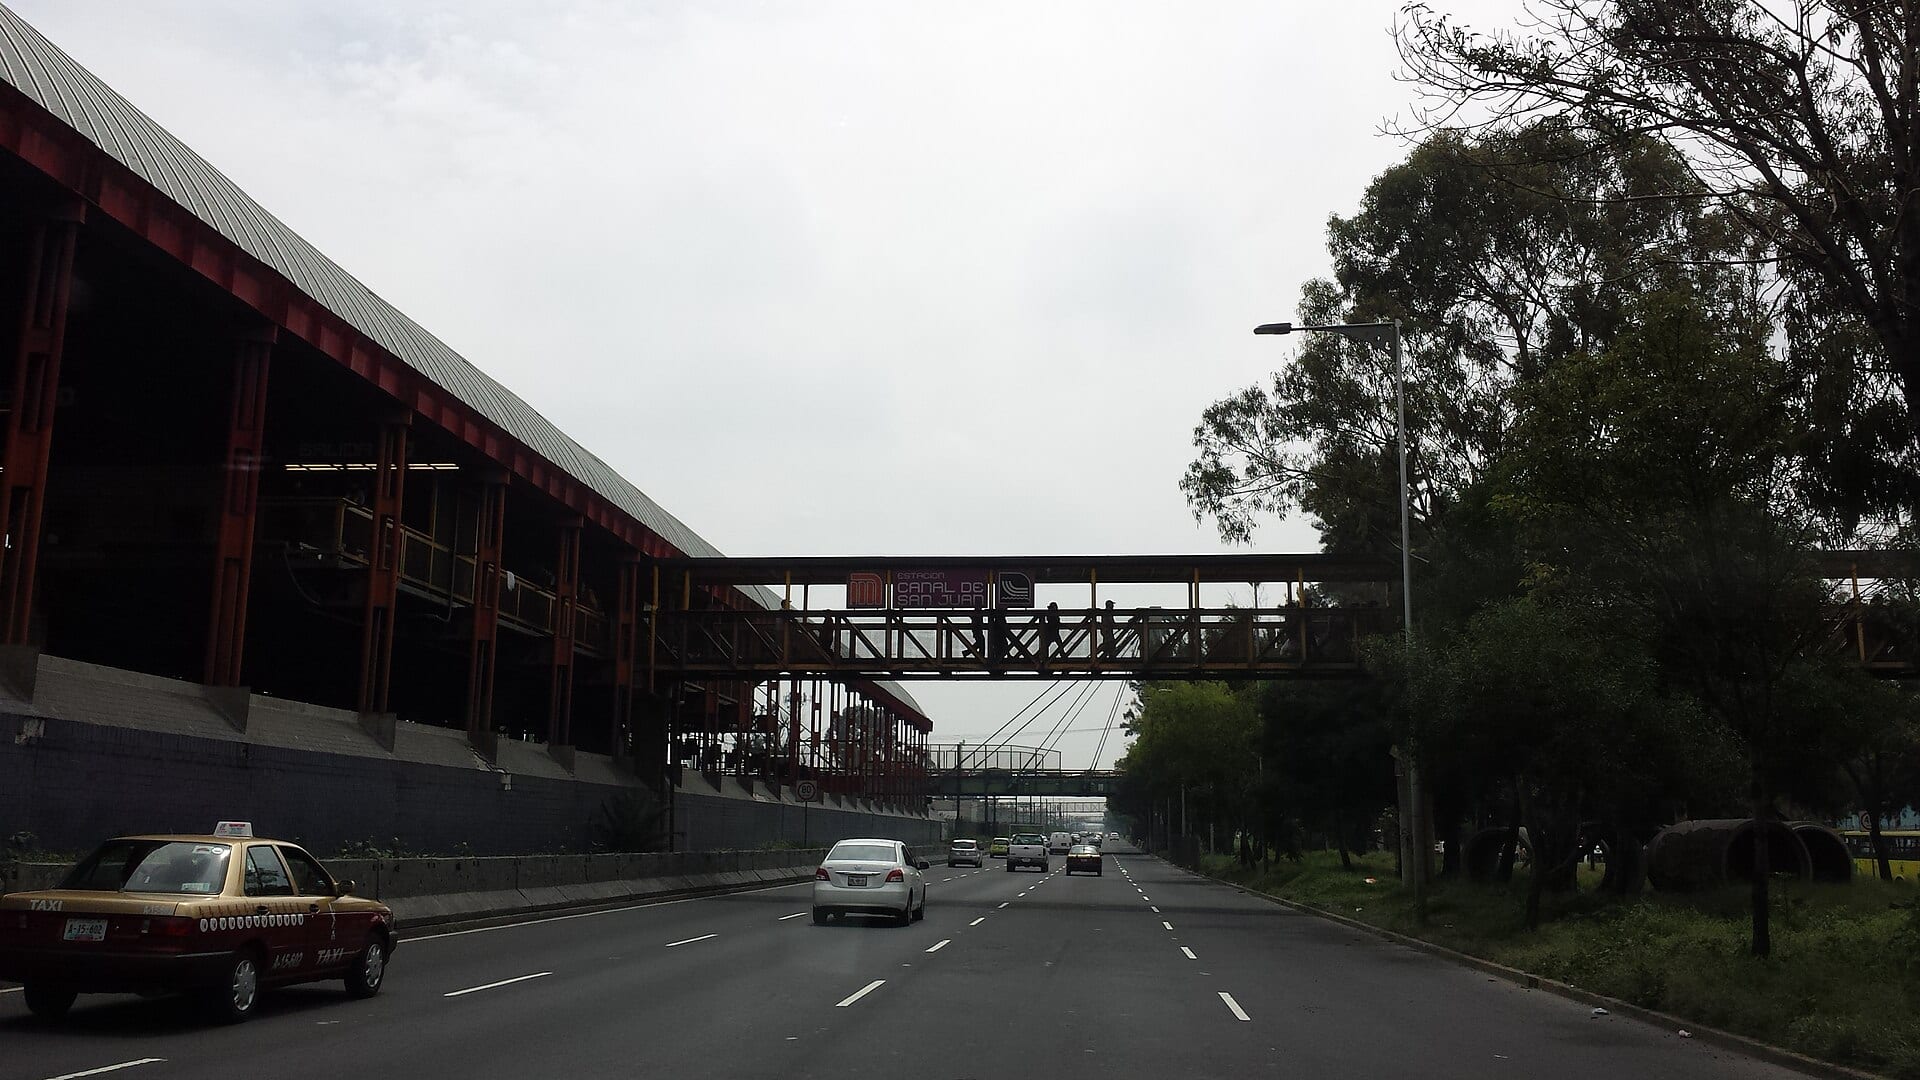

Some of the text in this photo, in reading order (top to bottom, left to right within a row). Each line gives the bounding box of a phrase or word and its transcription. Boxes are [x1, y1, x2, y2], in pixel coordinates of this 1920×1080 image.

[897, 582, 984, 593] CANAL DE
[897, 594, 984, 606] SAN JUAN
[30, 900, 63, 911] TAXI
[315, 947, 344, 965] TAXI
